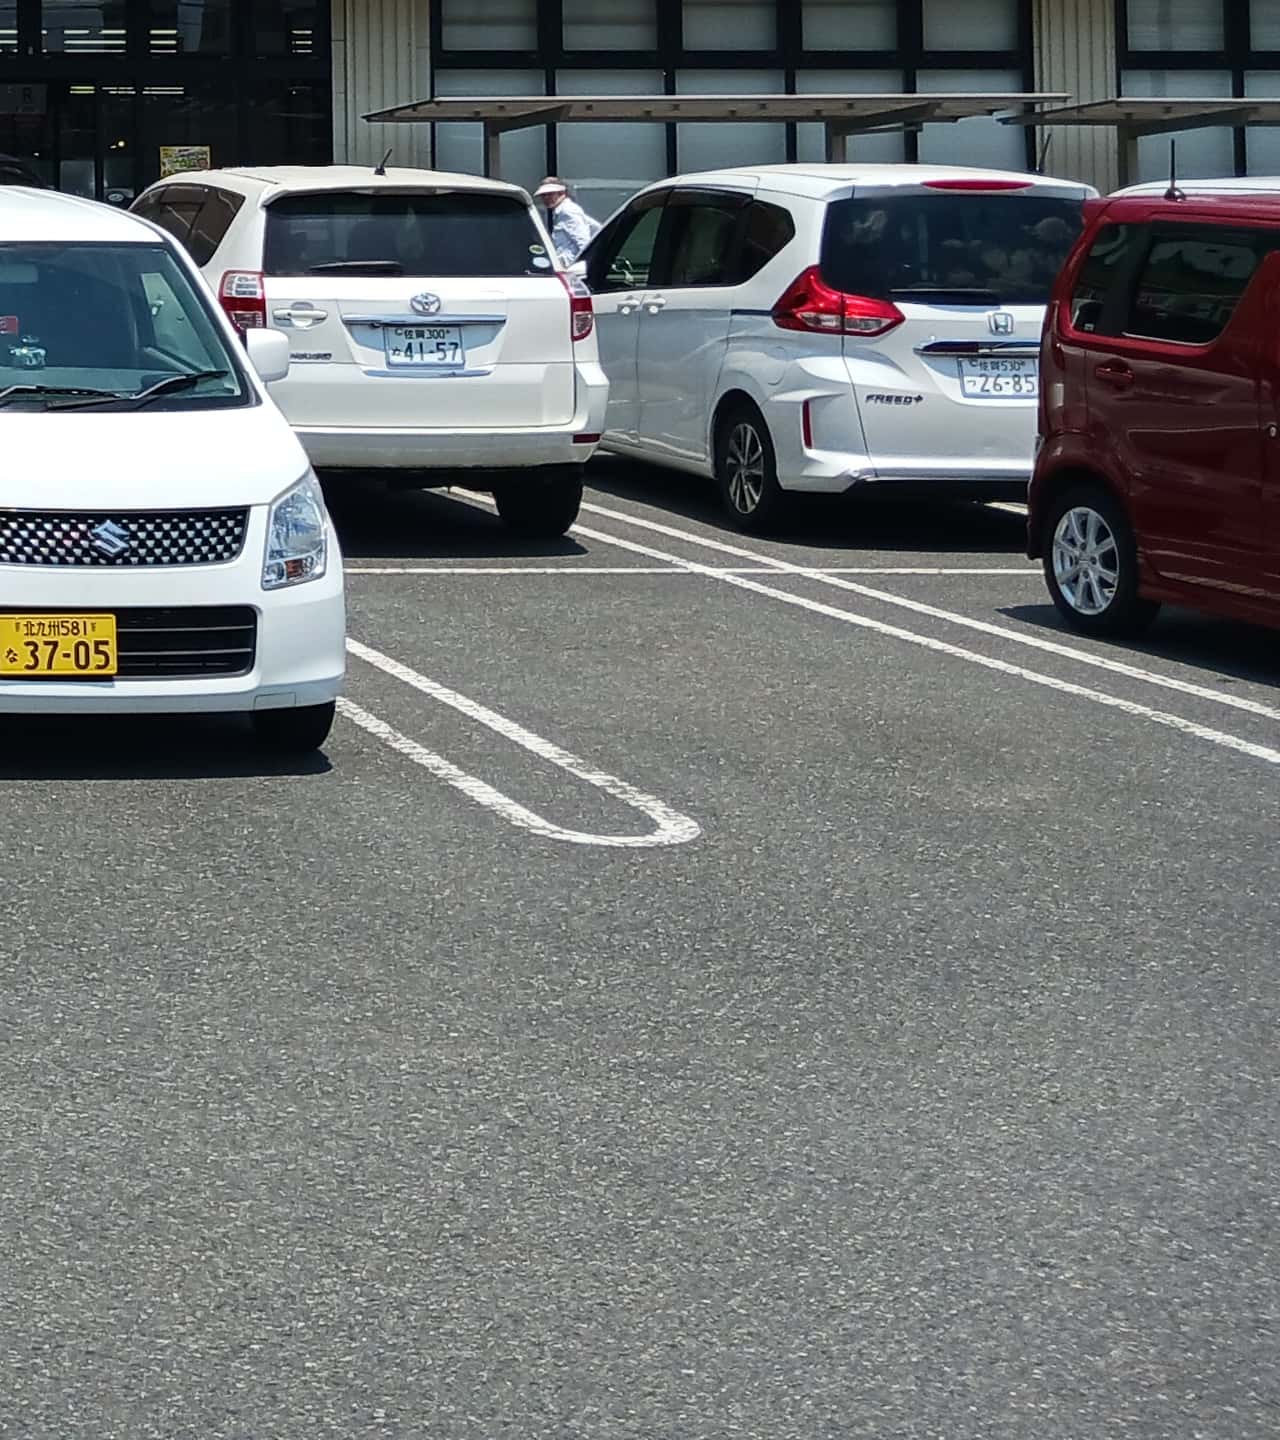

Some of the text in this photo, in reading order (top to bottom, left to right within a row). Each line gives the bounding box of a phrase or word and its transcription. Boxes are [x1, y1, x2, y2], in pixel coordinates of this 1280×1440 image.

[23, 620, 89, 637] 北九州581
[23, 639, 111, 671] 37-05
